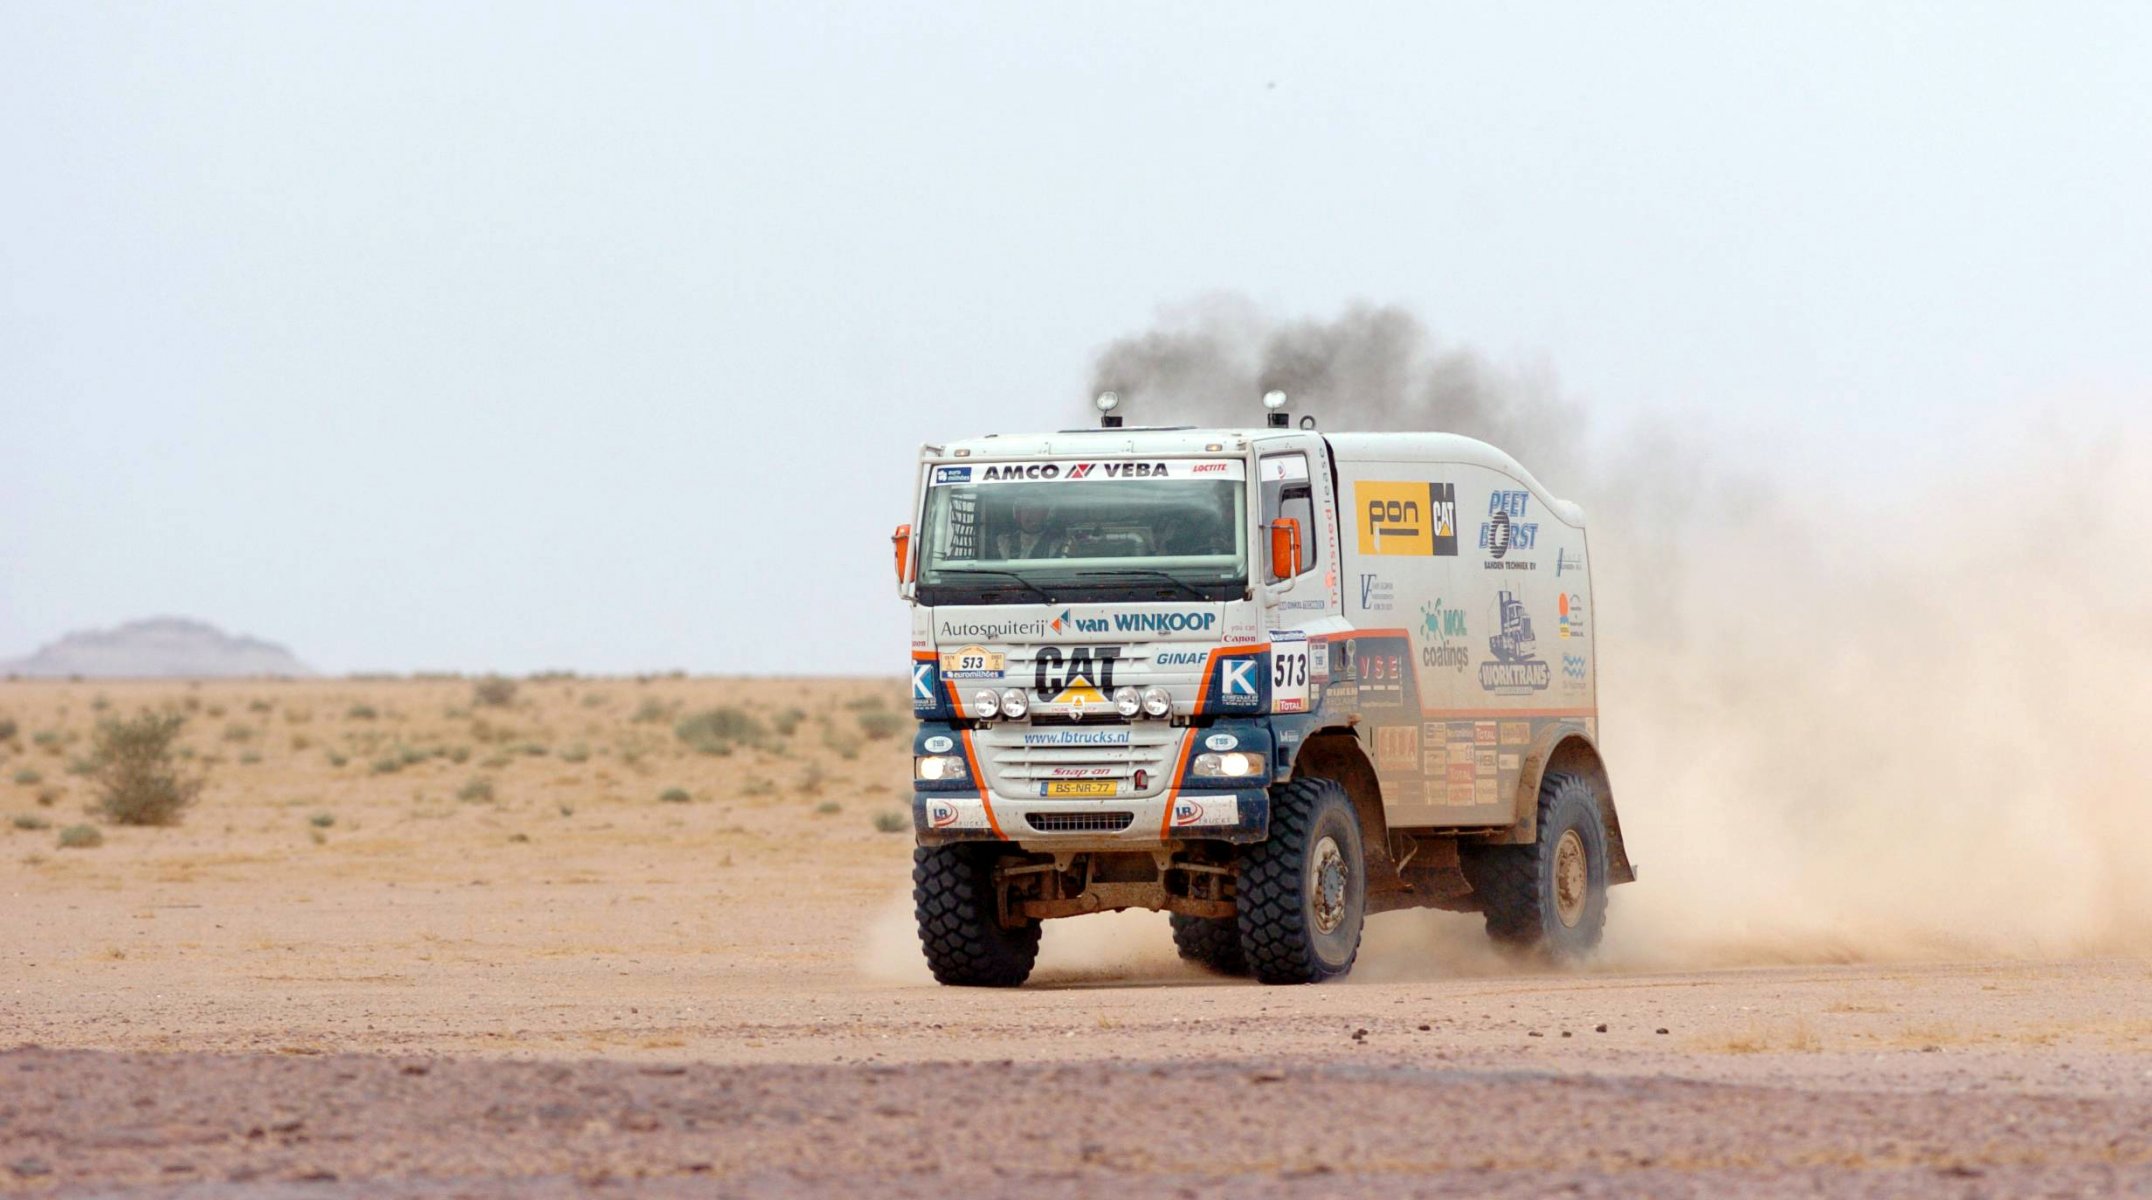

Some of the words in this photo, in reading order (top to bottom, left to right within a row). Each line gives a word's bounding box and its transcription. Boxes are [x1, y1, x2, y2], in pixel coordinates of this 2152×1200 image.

[983, 464, 1060, 480] AMCO
[1104, 463, 1169, 478] VEBA
[1193, 464, 1227, 473] LOCTITE
[1488, 490, 1530, 517] PEET
[1369, 500, 1419, 535] pon
[1433, 501, 1454, 537] CAT
[941, 620, 1045, 637] Autospuiterij
[1075, 618, 1110, 632] van
[1114, 612, 1216, 632] WINKOOP
[1223, 634, 1256, 643] Canon
[961, 656, 984, 669] 513
[1156, 652, 1208, 666] GINAF
[1423, 639, 1469, 673] coatings
[1035, 646, 1122, 703] CAT
[1221, 659, 1258, 695] K
[1274, 653, 1307, 688] 513
[1481, 663, 1548, 687] WORKTRANS
[1280, 700, 1302, 710] TOTAL
[1024, 731, 1131, 744] www.lbtrucks.nl
[1055, 783, 1110, 793] BS-NR-77
